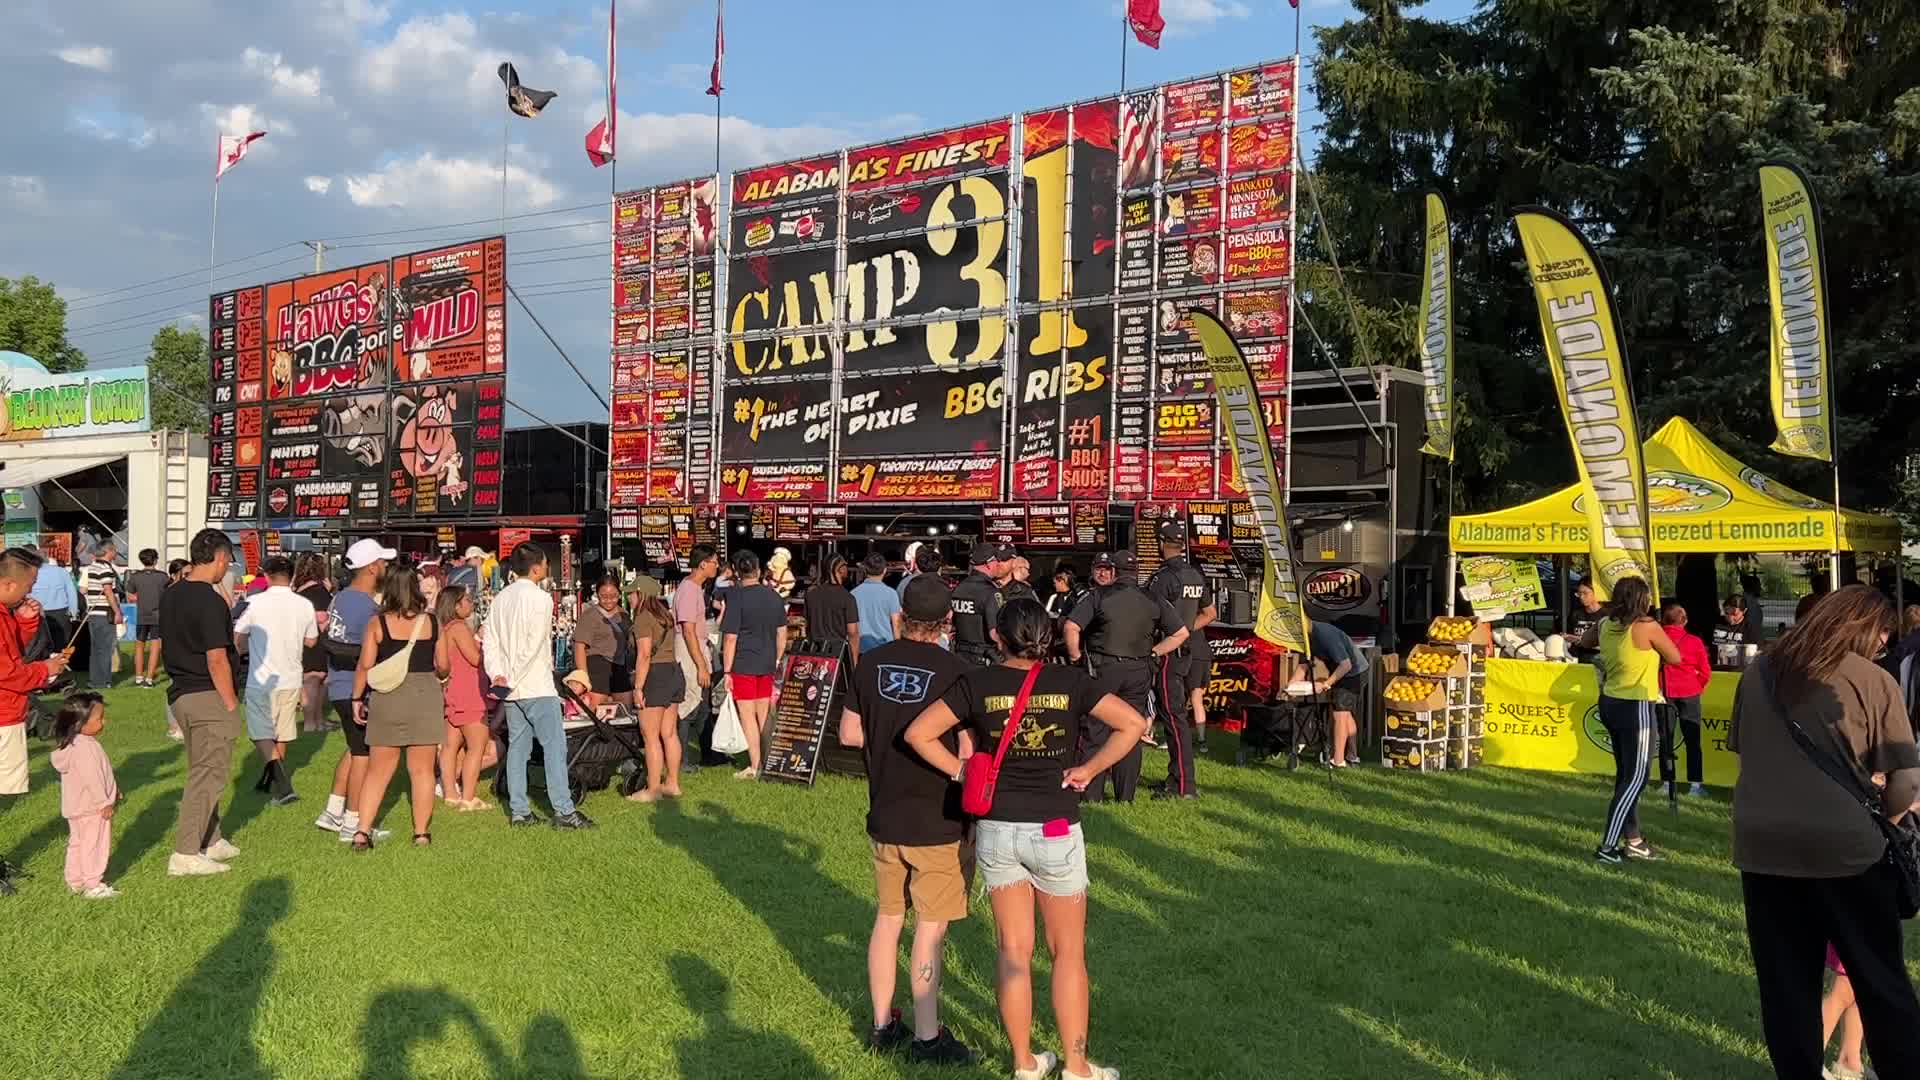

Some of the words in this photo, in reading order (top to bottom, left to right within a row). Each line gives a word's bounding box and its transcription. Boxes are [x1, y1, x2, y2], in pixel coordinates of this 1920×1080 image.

[743, 158, 889, 202] ALABAMA'S
[895, 135, 1007, 179] FINEST
[1231, 178, 1273, 194] MANKATO
[617, 194, 650, 207] SYDNEY
[1230, 188, 1276, 205] MINNESOTA
[1132, 209, 1144, 219] OF
[1230, 202, 1258, 214] BEST
[1230, 210, 1257, 221] RIBS
[1228, 229, 1285, 249] PENSACOLA
[730, 250, 920, 375] CAMP
[927, 145, 1088, 374] 31
[1249, 246, 1272, 261] BBQ
[402, 288, 480, 353] WILD
[1159, 351, 1190, 365] WINSTON
[1191, 350, 1208, 362] SAL
[1025, 355, 1107, 404] RIBS
[215, 386, 232, 403] PIG
[239, 384, 260, 400] OUT
[90, 378, 146, 426] ONION
[733, 396, 765, 442] #1
[759, 409, 799, 433] THE
[804, 391, 881, 421] HEART
[1161, 405, 1196, 417] PIG
[803, 423, 831, 444] OF
[848, 403, 919, 437] DIXIE
[1068, 414, 1101, 446] #1
[1159, 415, 1199, 429] OUT
[654, 428, 686, 438] TORONTO
[270, 444, 320, 461] WHITBY
[1071, 448, 1102, 470] BBQ
[721, 467, 750, 499] #1
[752, 464, 825, 477] BURLINGTON
[840, 463, 877, 496] #1
[878, 461, 926, 474] TORONTO'S
[925, 459, 961, 472] LARGEST
[884, 475, 918, 484] FIRST
[919, 474, 957, 484] PLACE
[1063, 468, 1107, 490] SAUCE
[877, 485, 906, 497] RIBS
[907, 485, 917, 496] &
[919, 484, 961, 497] SAUCE
[209, 502, 231, 518] LETS
[238, 502, 257, 517] EAT
[1030, 506, 1050, 515] GRAND
[1051, 505, 1069, 515] SLAM
[1188, 503, 1203, 514] WE
[1203, 503, 1227, 514] HAVE
[1193, 514, 1214, 525] BEEF
[1215, 516, 1222, 525] &
[1196, 524, 1219, 536] PORK
[1457, 520, 1545, 543] Alabama's
[1550, 521, 1589, 543] Fres
[1719, 516, 1825, 541] Lemonade
[1199, 535, 1218, 546] RIBS
[1183, 585, 1204, 599] POLIC
[1307, 581, 1340, 594] CAMP
[1339, 574, 1362, 598] 31
[1512, 584, 1536, 594] Shot
[1523, 592, 1541, 606] $1
[1027, 693, 1071, 712] ELIGION
[1498, 702, 1566, 725] SQUEEZE
[1503, 723, 1559, 739] PLEASE
